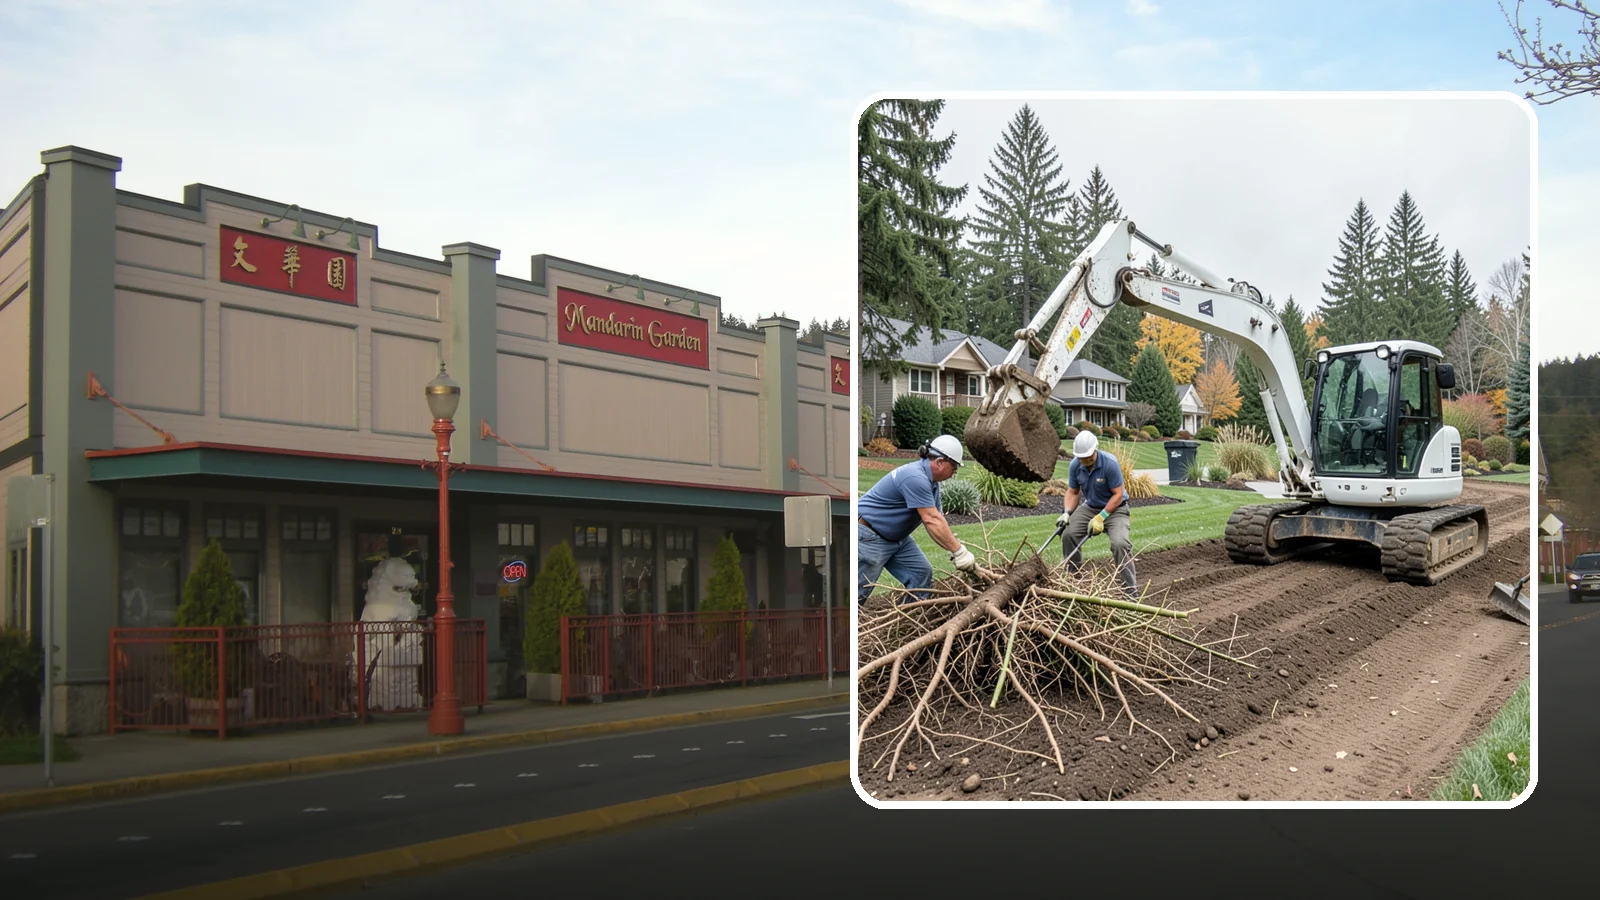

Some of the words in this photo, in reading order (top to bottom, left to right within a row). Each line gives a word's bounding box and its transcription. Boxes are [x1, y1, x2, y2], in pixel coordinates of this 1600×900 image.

[230, 235, 346, 291] 文華園
[564, 302, 644, 341] Mandarin
[647, 320, 702, 352] Garden
[503, 565, 527, 578] OPEN
